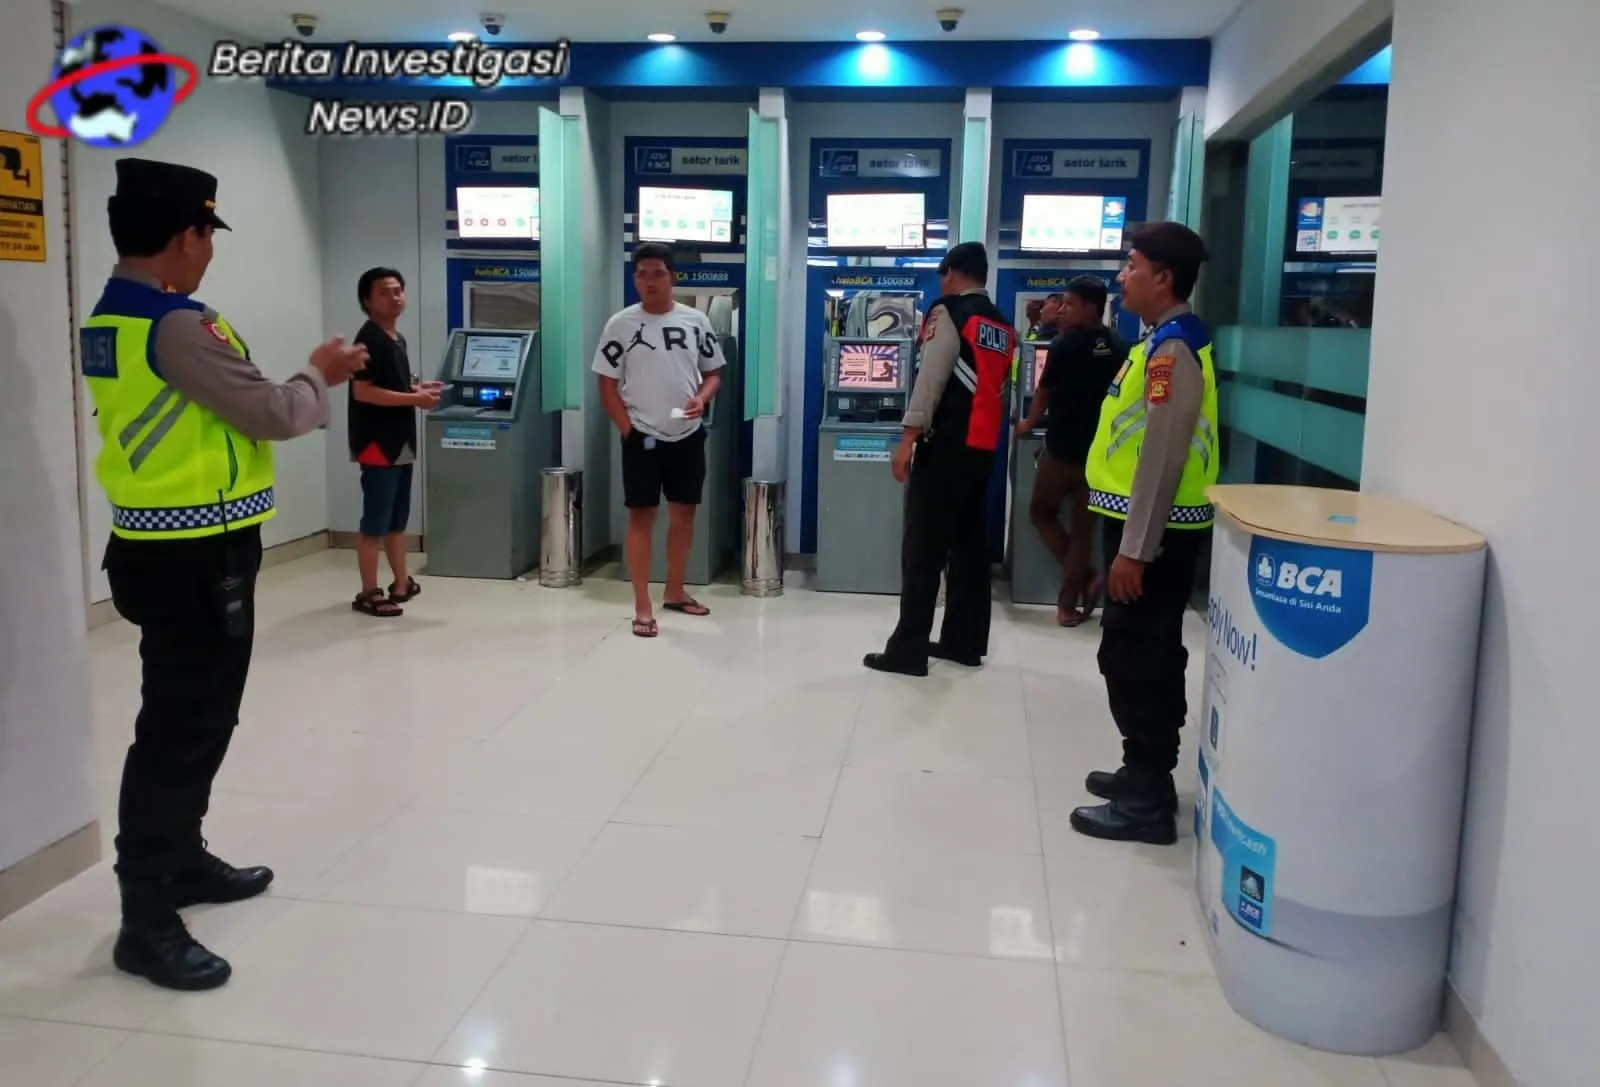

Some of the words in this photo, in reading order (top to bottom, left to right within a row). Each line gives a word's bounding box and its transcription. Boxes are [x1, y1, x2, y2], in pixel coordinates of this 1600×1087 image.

[501, 153, 531, 163] setor
[682, 155, 712, 165] setor
[714, 154, 740, 165] tarik
[869, 158, 899, 168] setor
[1064, 157, 1095, 168] setor
[1098, 157, 1127, 168] tarik
[1276, 561, 1343, 598] BCA
[1289, 597, 1297, 607] di
[1299, 599, 1313, 609] Sisi
[1315, 602, 1342, 614] Anda
[1223, 607, 1257, 671] Now!
